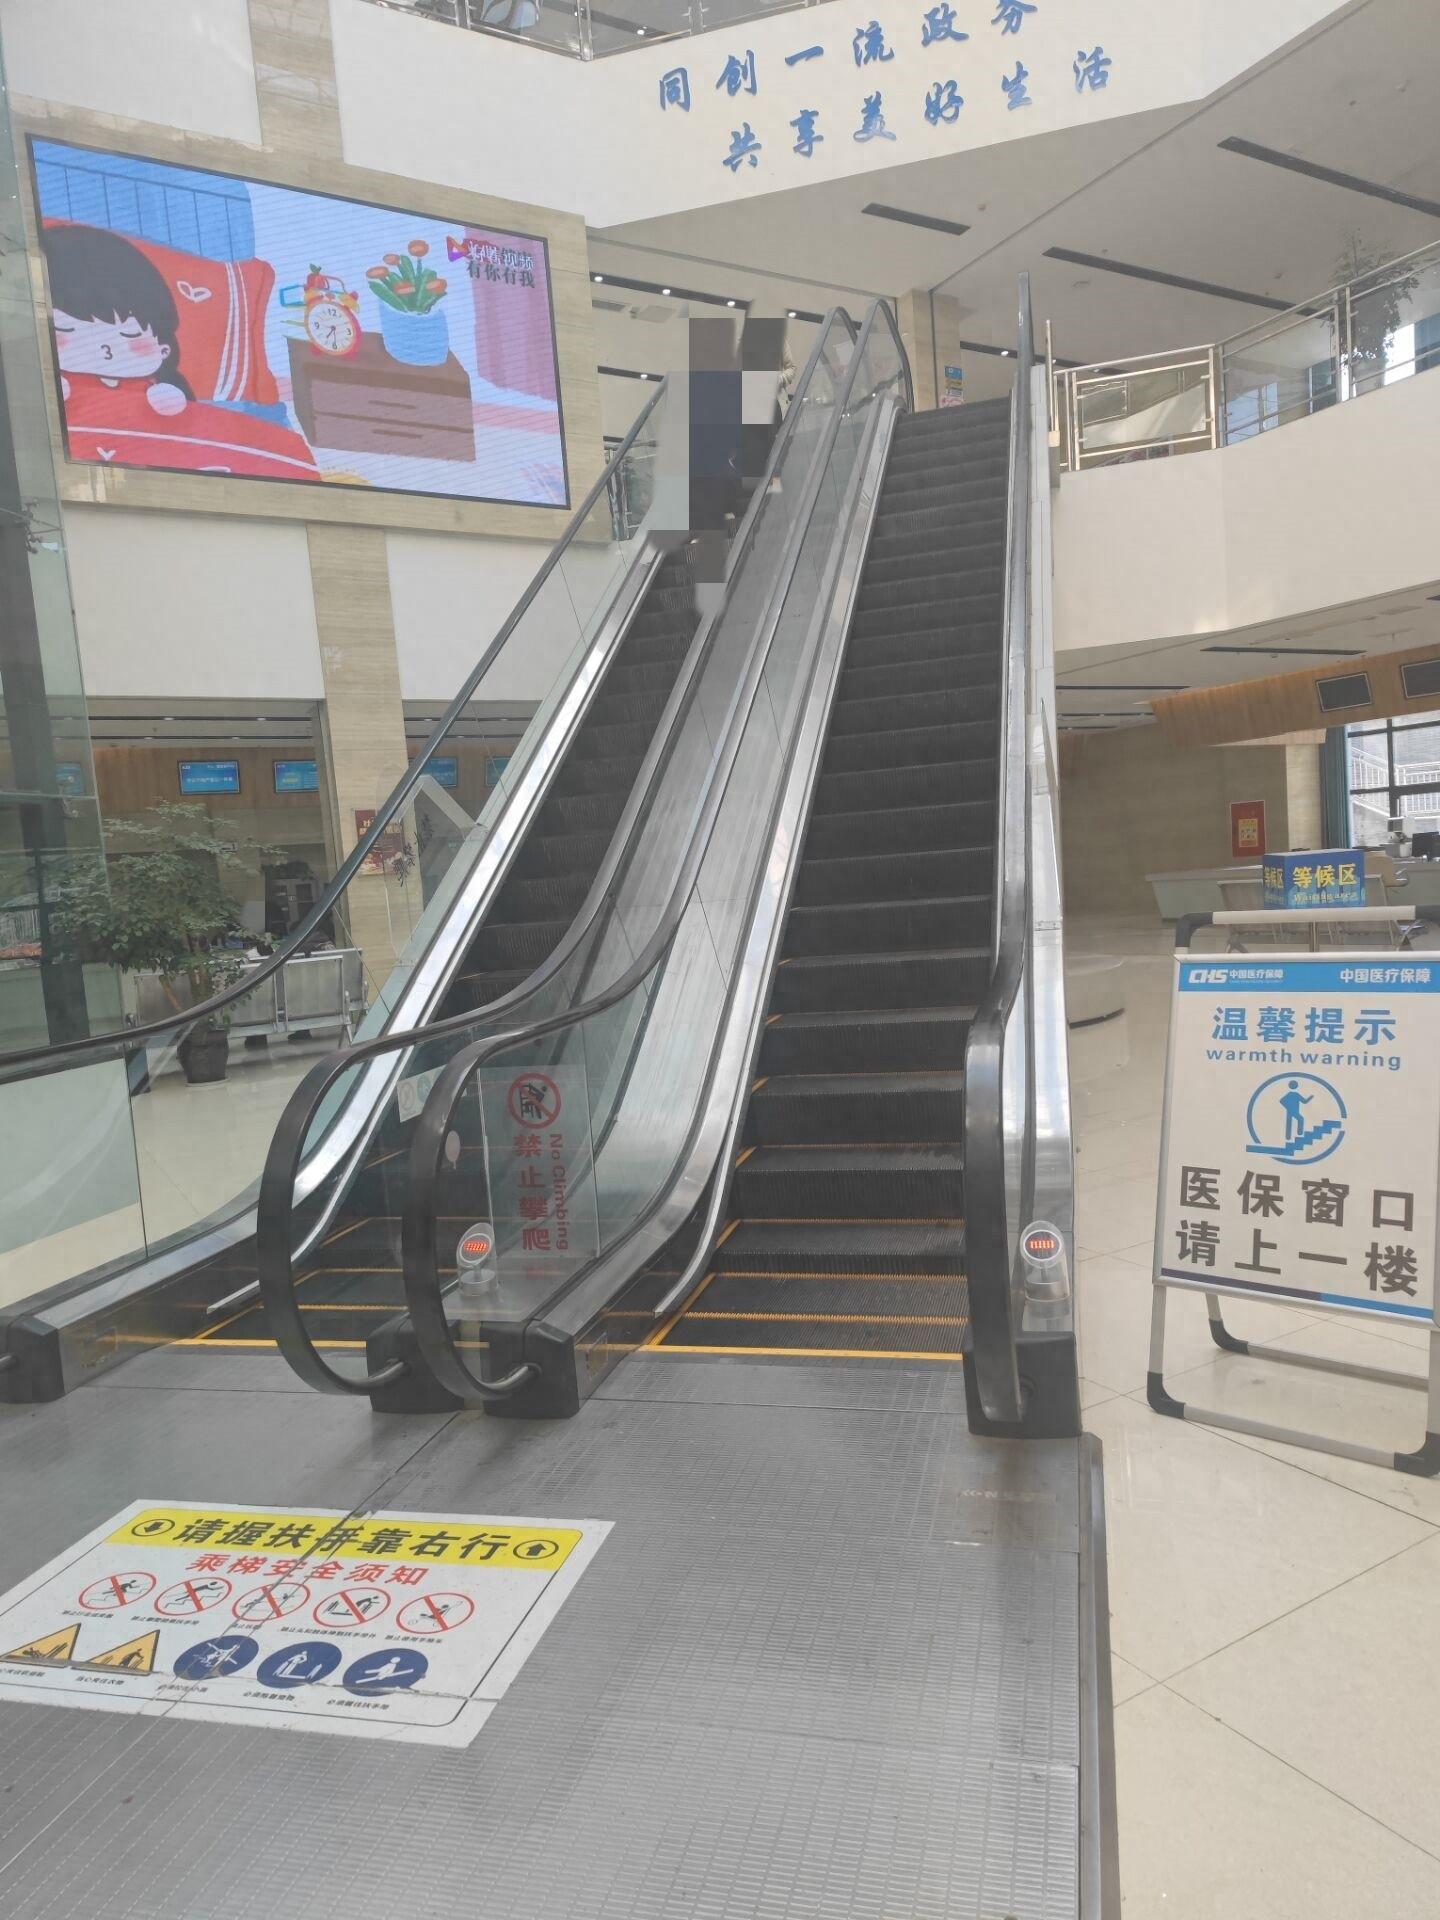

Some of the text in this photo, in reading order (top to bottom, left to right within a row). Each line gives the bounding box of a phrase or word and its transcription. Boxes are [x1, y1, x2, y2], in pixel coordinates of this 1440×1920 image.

[658, 0, 1039, 112] 同创一流政务
[722, 46, 1113, 173] 共享美好生活
[1292, 863, 1358, 888] 等候区
[1229, 968, 1432, 984] 中国医疗保障 中国医疗保障
[1211, 1006, 1397, 1046] 温馨提示
[1206, 1048, 1401, 1071] warmth warning
[513, 1133, 551, 1251] 禁止攀爬
[550, 1132, 570, 1251] No Climbing
[1180, 1165, 1415, 1232] 医保窗口
[1175, 1220, 1419, 1297] 请上一楼
[171, 1517, 512, 1562] 请握扶手靠右行
[185, 1552, 429, 1586] 乘梯安全须知
